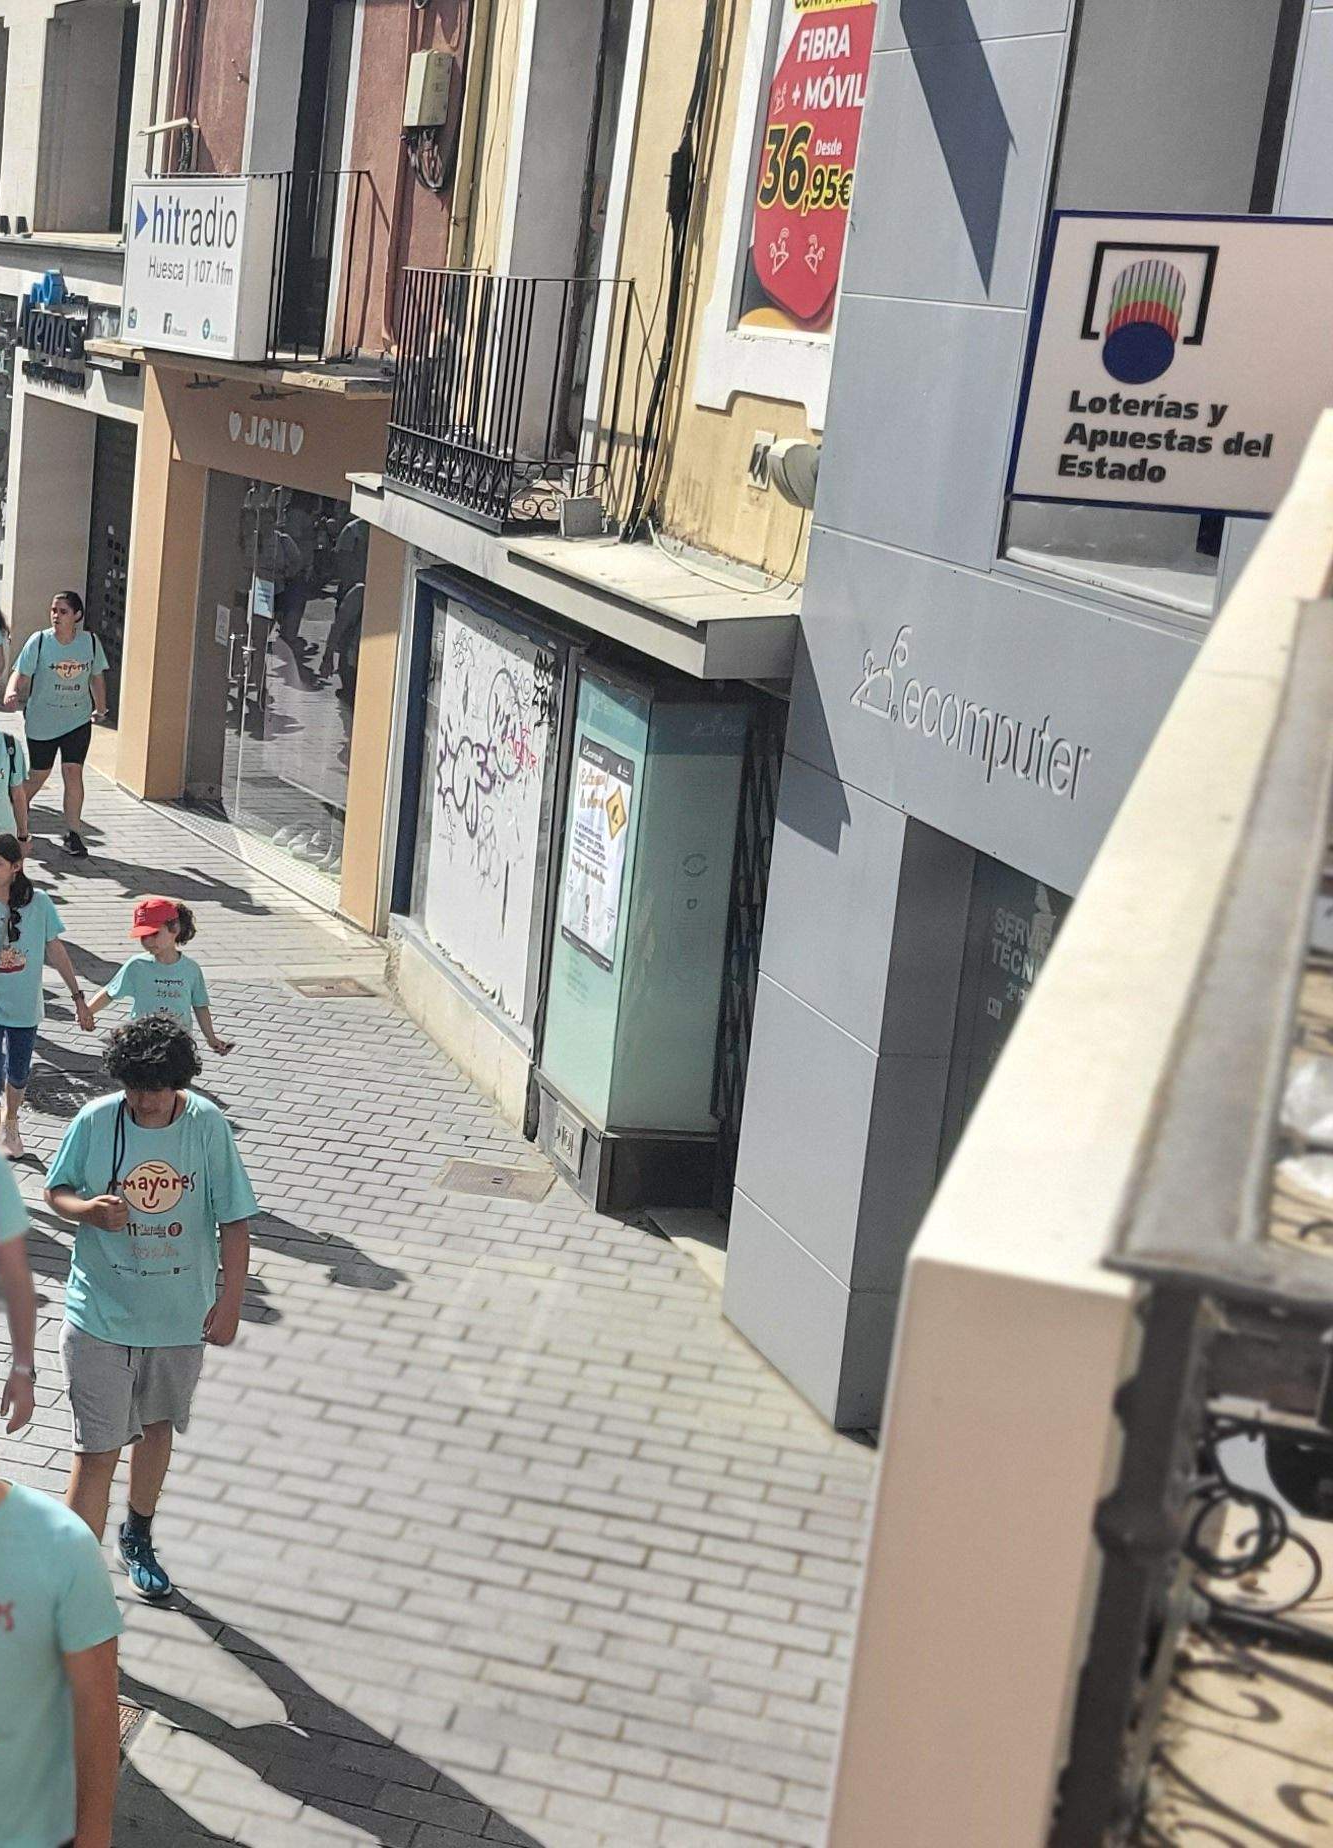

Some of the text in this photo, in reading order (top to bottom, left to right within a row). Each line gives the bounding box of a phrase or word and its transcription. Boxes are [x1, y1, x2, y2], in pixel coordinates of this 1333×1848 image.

[796, 24, 851, 63] FIBRA
[803, 66, 866, 110] MÓVIL
[815, 138, 843, 156] Desde
[151, 195, 238, 249] hitradio
[148, 255, 184, 281] Huesca
[1068, 390, 1229, 428] Loterías y
[1064, 422, 1274, 458] Apuestas del
[1058, 454, 1167, 483] Estado
[902, 678, 1092, 800] ecomputer
[127, 1223, 137, 1236] 11
